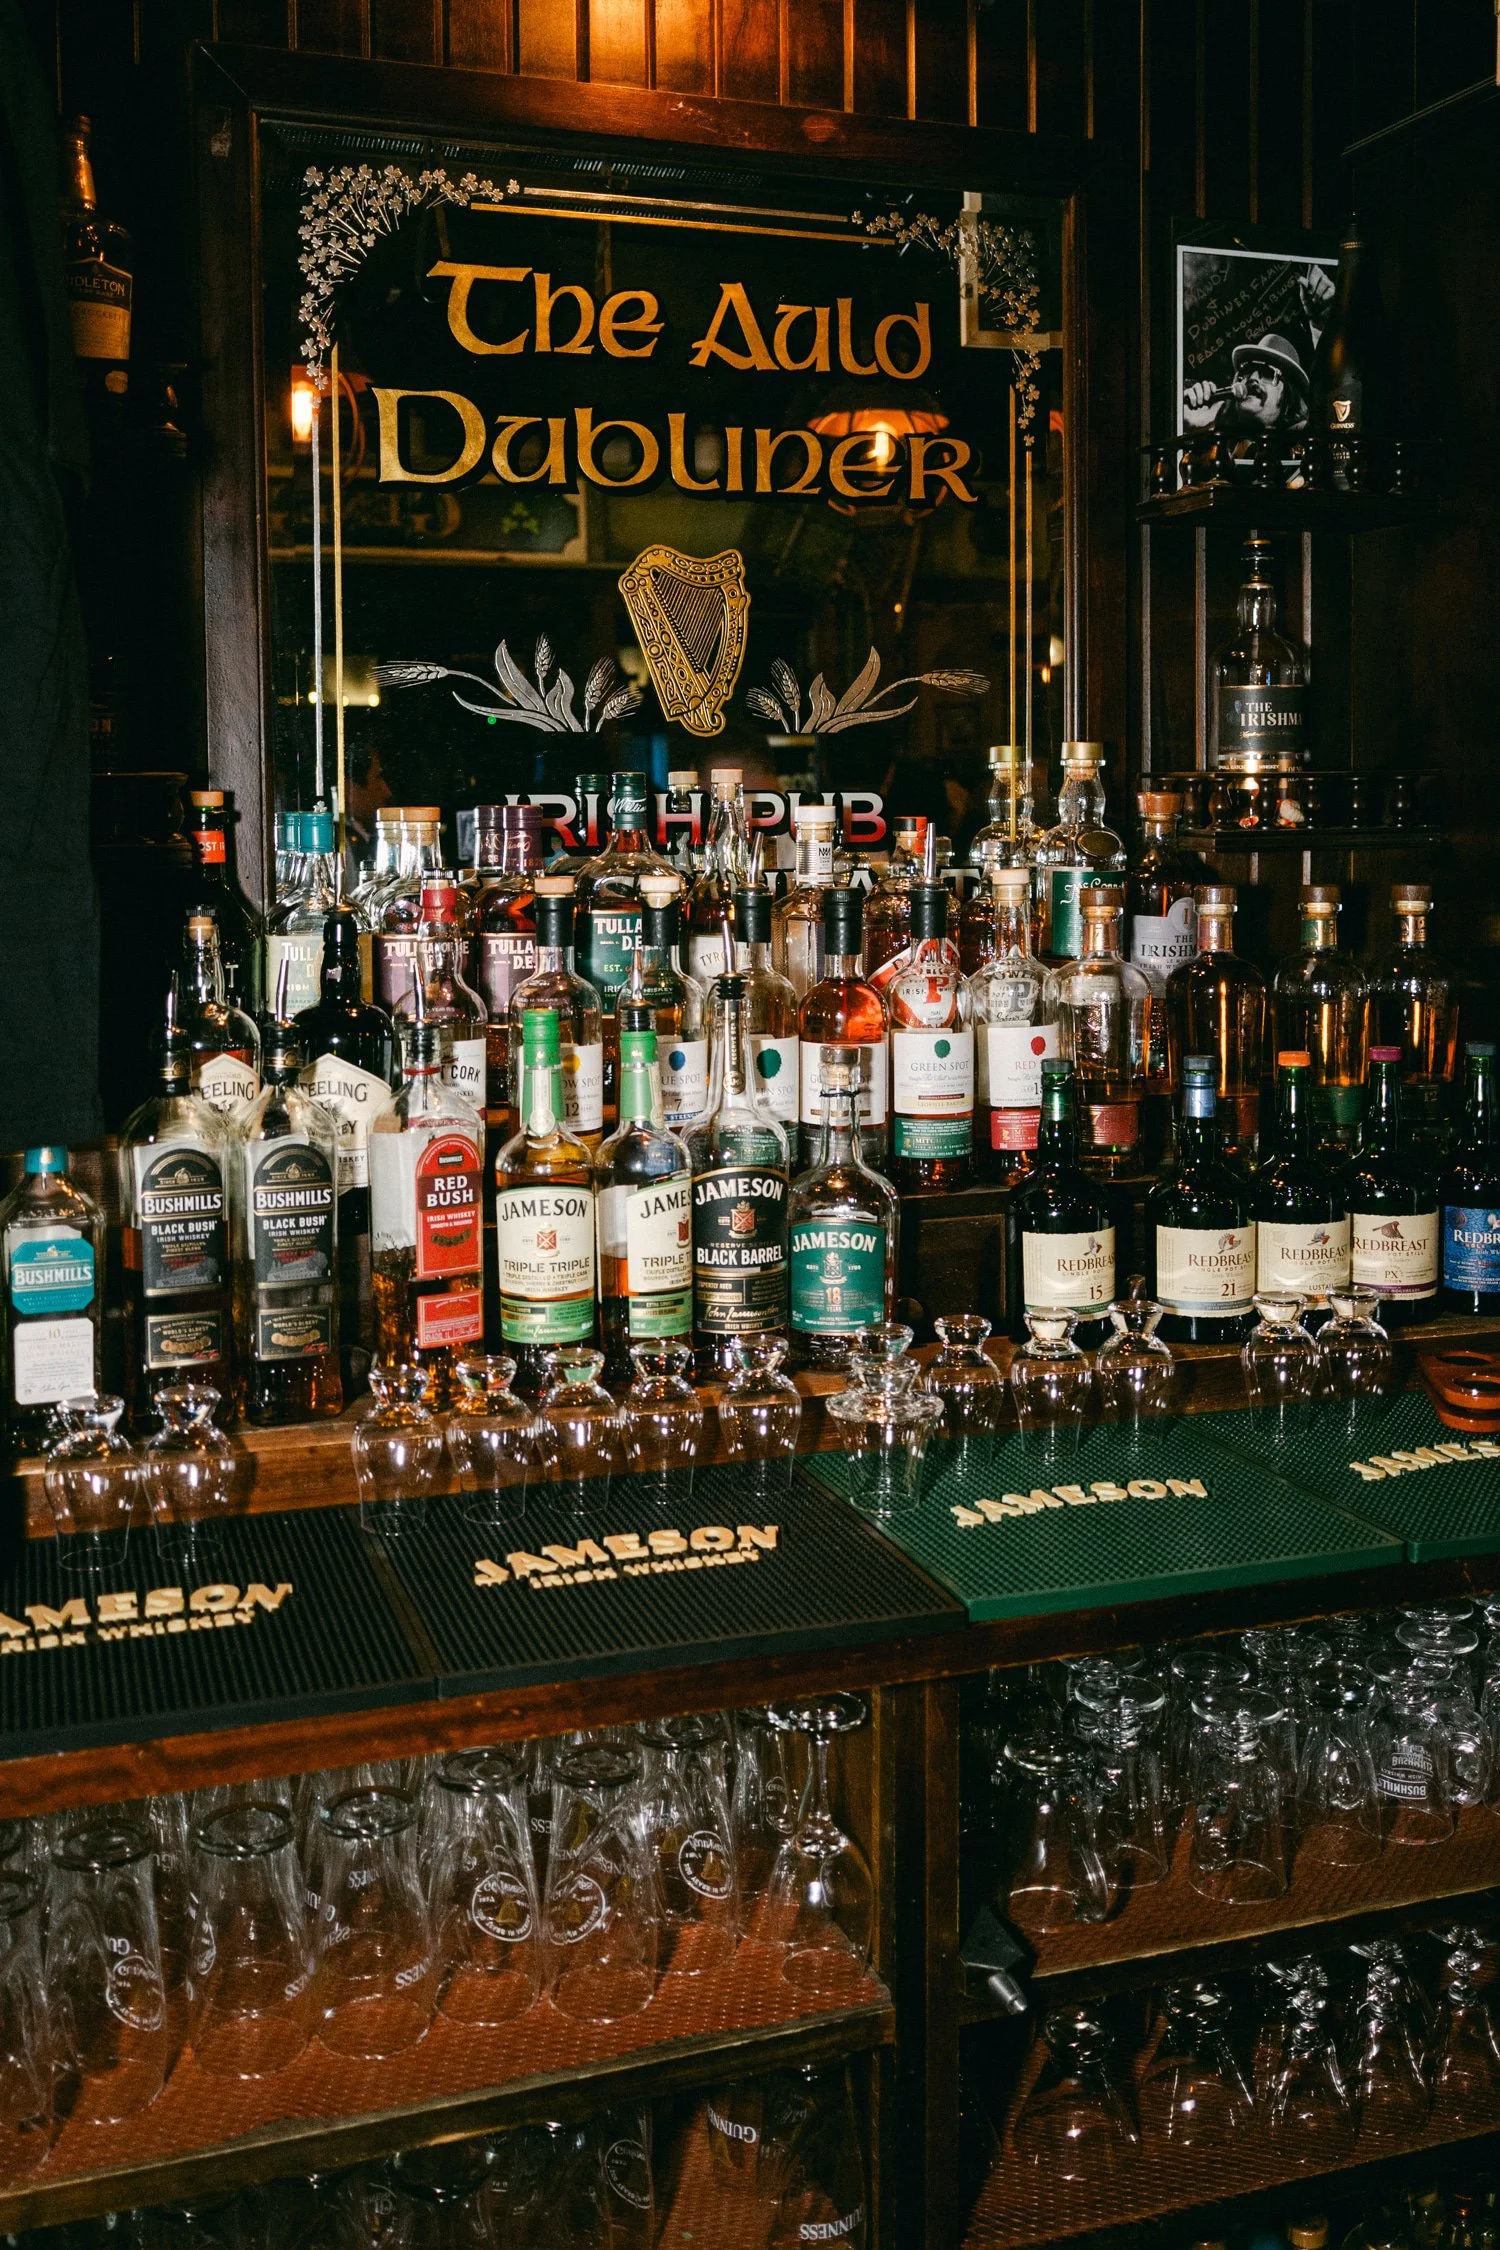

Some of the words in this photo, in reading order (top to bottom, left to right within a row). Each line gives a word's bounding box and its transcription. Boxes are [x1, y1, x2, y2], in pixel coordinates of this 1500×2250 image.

[426, 260, 665, 358] The
[689, 281, 931, 380] Auld
[1245, 702, 1273, 712] THE
[451, 1064, 481, 1083] CORK
[911, 1061, 947, 1072] GREEN
[950, 1060, 969, 1071] SPOT
[1015, 1061, 1036, 1070] RED
[565, 1102, 580, 1117] 12
[675, 1098, 683, 1112] 7
[434, 1176, 468, 1192] RED
[695, 1178, 784, 1206] JAMESON
[144, 1194, 221, 1214] BUSHMILLS
[256, 1189, 331, 1209] BUSHMILLS
[427, 1190, 474, 1208] BUSH
[427, 1213, 445, 1223] IRISH
[447, 1211, 475, 1221] WHISKEY
[502, 1199, 588, 1221] JAMESON
[151, 1222, 184, 1236] BLACK
[189, 1220, 217, 1234] BUSH
[263, 1217, 296, 1230] BLACK
[299, 1215, 327, 1228] BUSH
[157, 1234, 176, 1242] IRISH
[179, 1233, 210, 1241] WHISKEY
[269, 1229, 287, 1237] IRISH
[290, 1228, 320, 1236] WHISKEY
[792, 1231, 877, 1253] JAMESON
[642, 1257, 683, 1268] TRIPLE
[697, 1247, 737, 1265] BLACK
[741, 1246, 783, 1265] BARREL
[503, 1259, 545, 1273] TRIPLE
[549, 1257, 590, 1272] TRIPLE
[14, 1265, 92, 1286] BUSHMILLS
[1385, 1271, 1399, 1279] PX
[825, 1287, 842, 1305] 18
[1089, 1285, 1103, 1300] 15
[1221, 1283, 1236, 1296] 21
[950, 1478, 1208, 1528] JAMESON
[473, 1524, 780, 1587] JAMESON
[531, 1566, 616, 1590] IRISH
[624, 1549, 760, 1579] WHISKEY
[97, 1610, 256, 1641] WHISKEY
[799, 2203, 864, 2241] UINNESS
